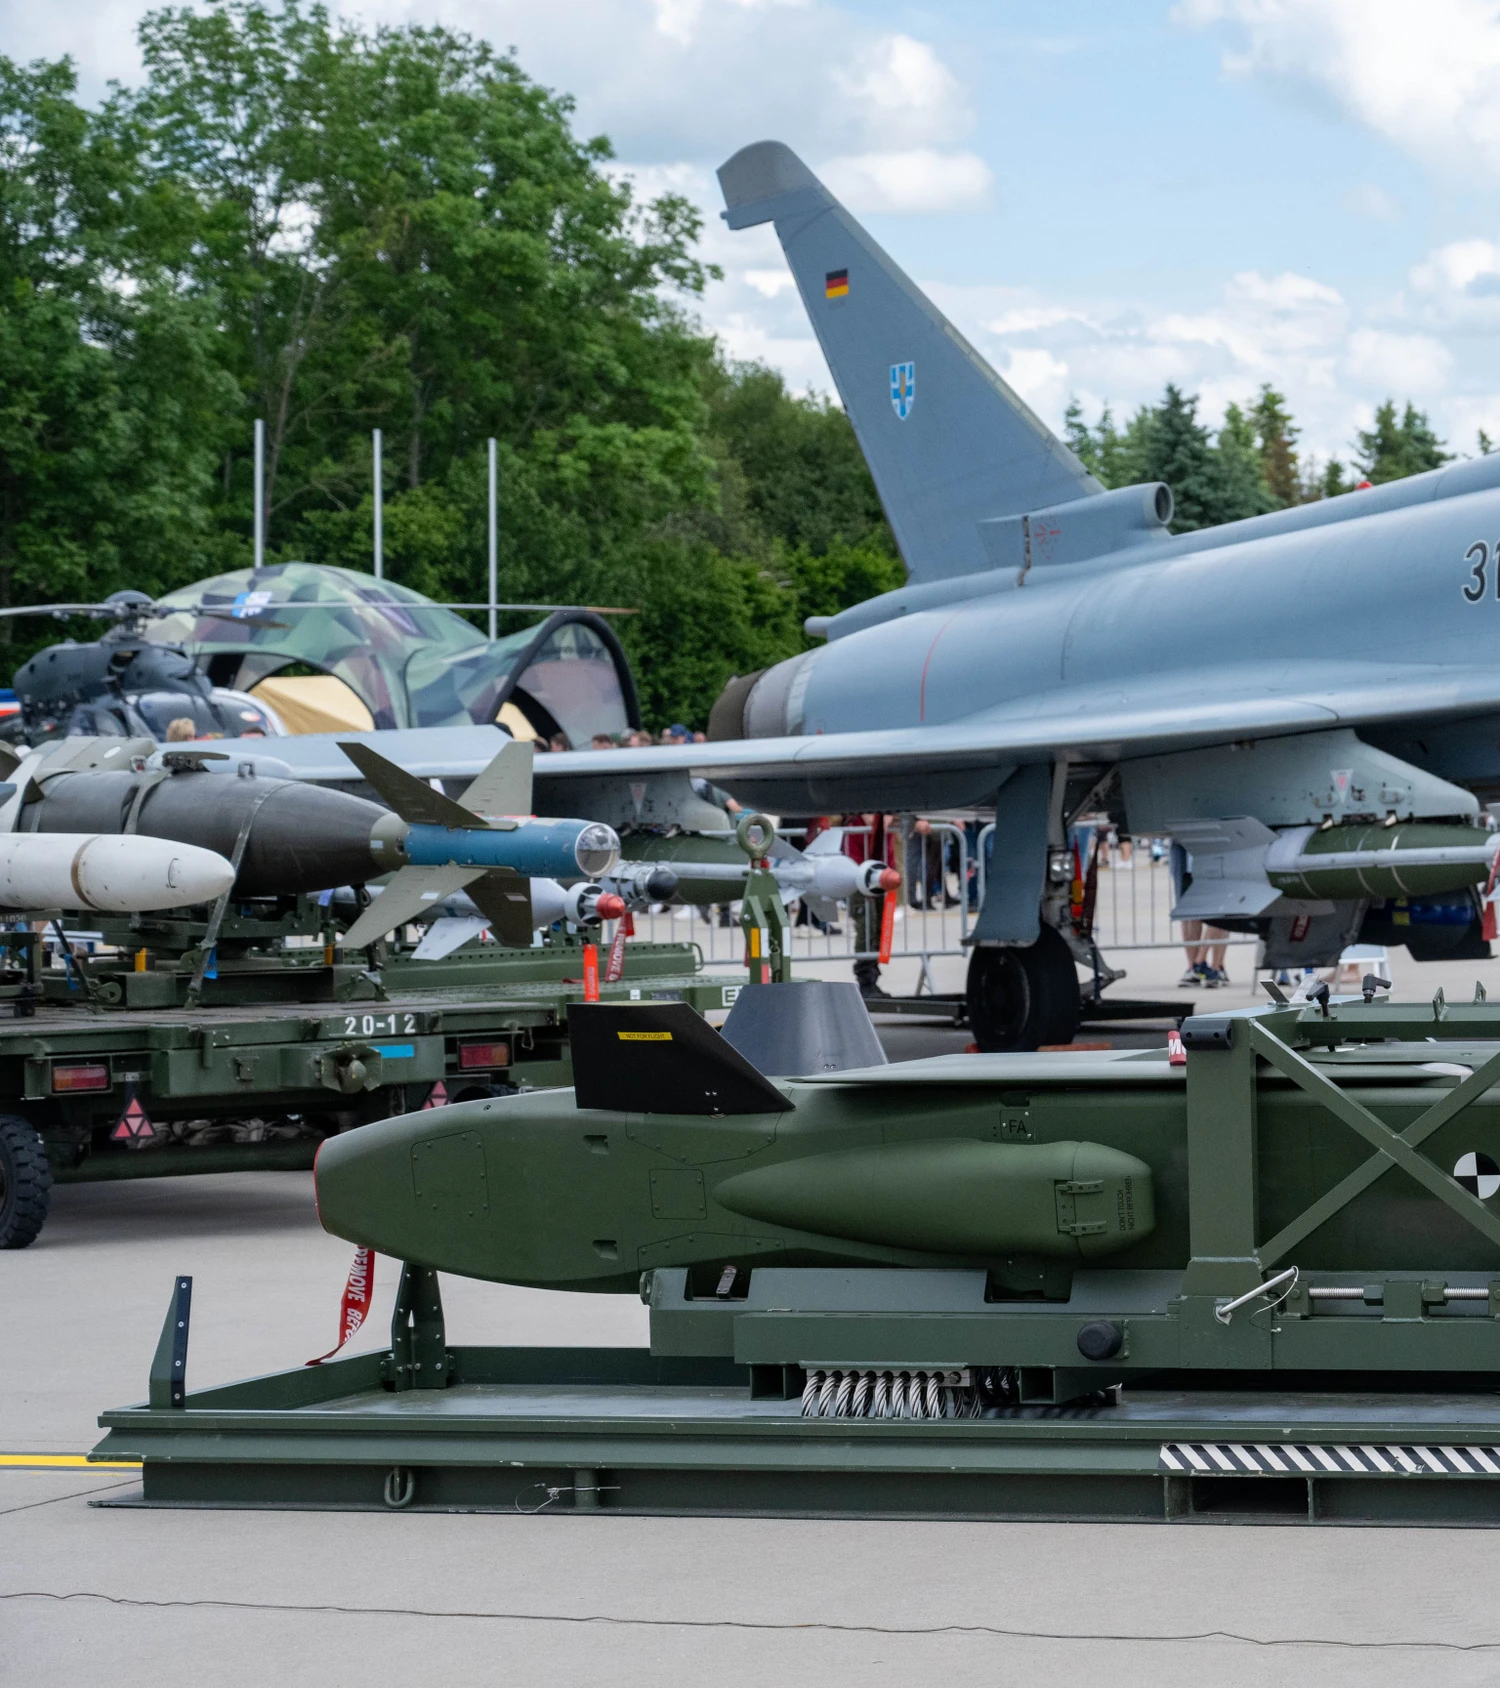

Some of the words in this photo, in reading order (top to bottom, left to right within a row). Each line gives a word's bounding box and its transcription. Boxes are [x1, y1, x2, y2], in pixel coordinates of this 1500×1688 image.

[344, 1013, 416, 1035] 20-12
[1009, 1119, 1027, 1134] FA
[1116, 1189, 1125, 1211] TOUCH
[1127, 1211, 1135, 1230] NICHT
[348, 1246, 369, 1302] REMOVE
